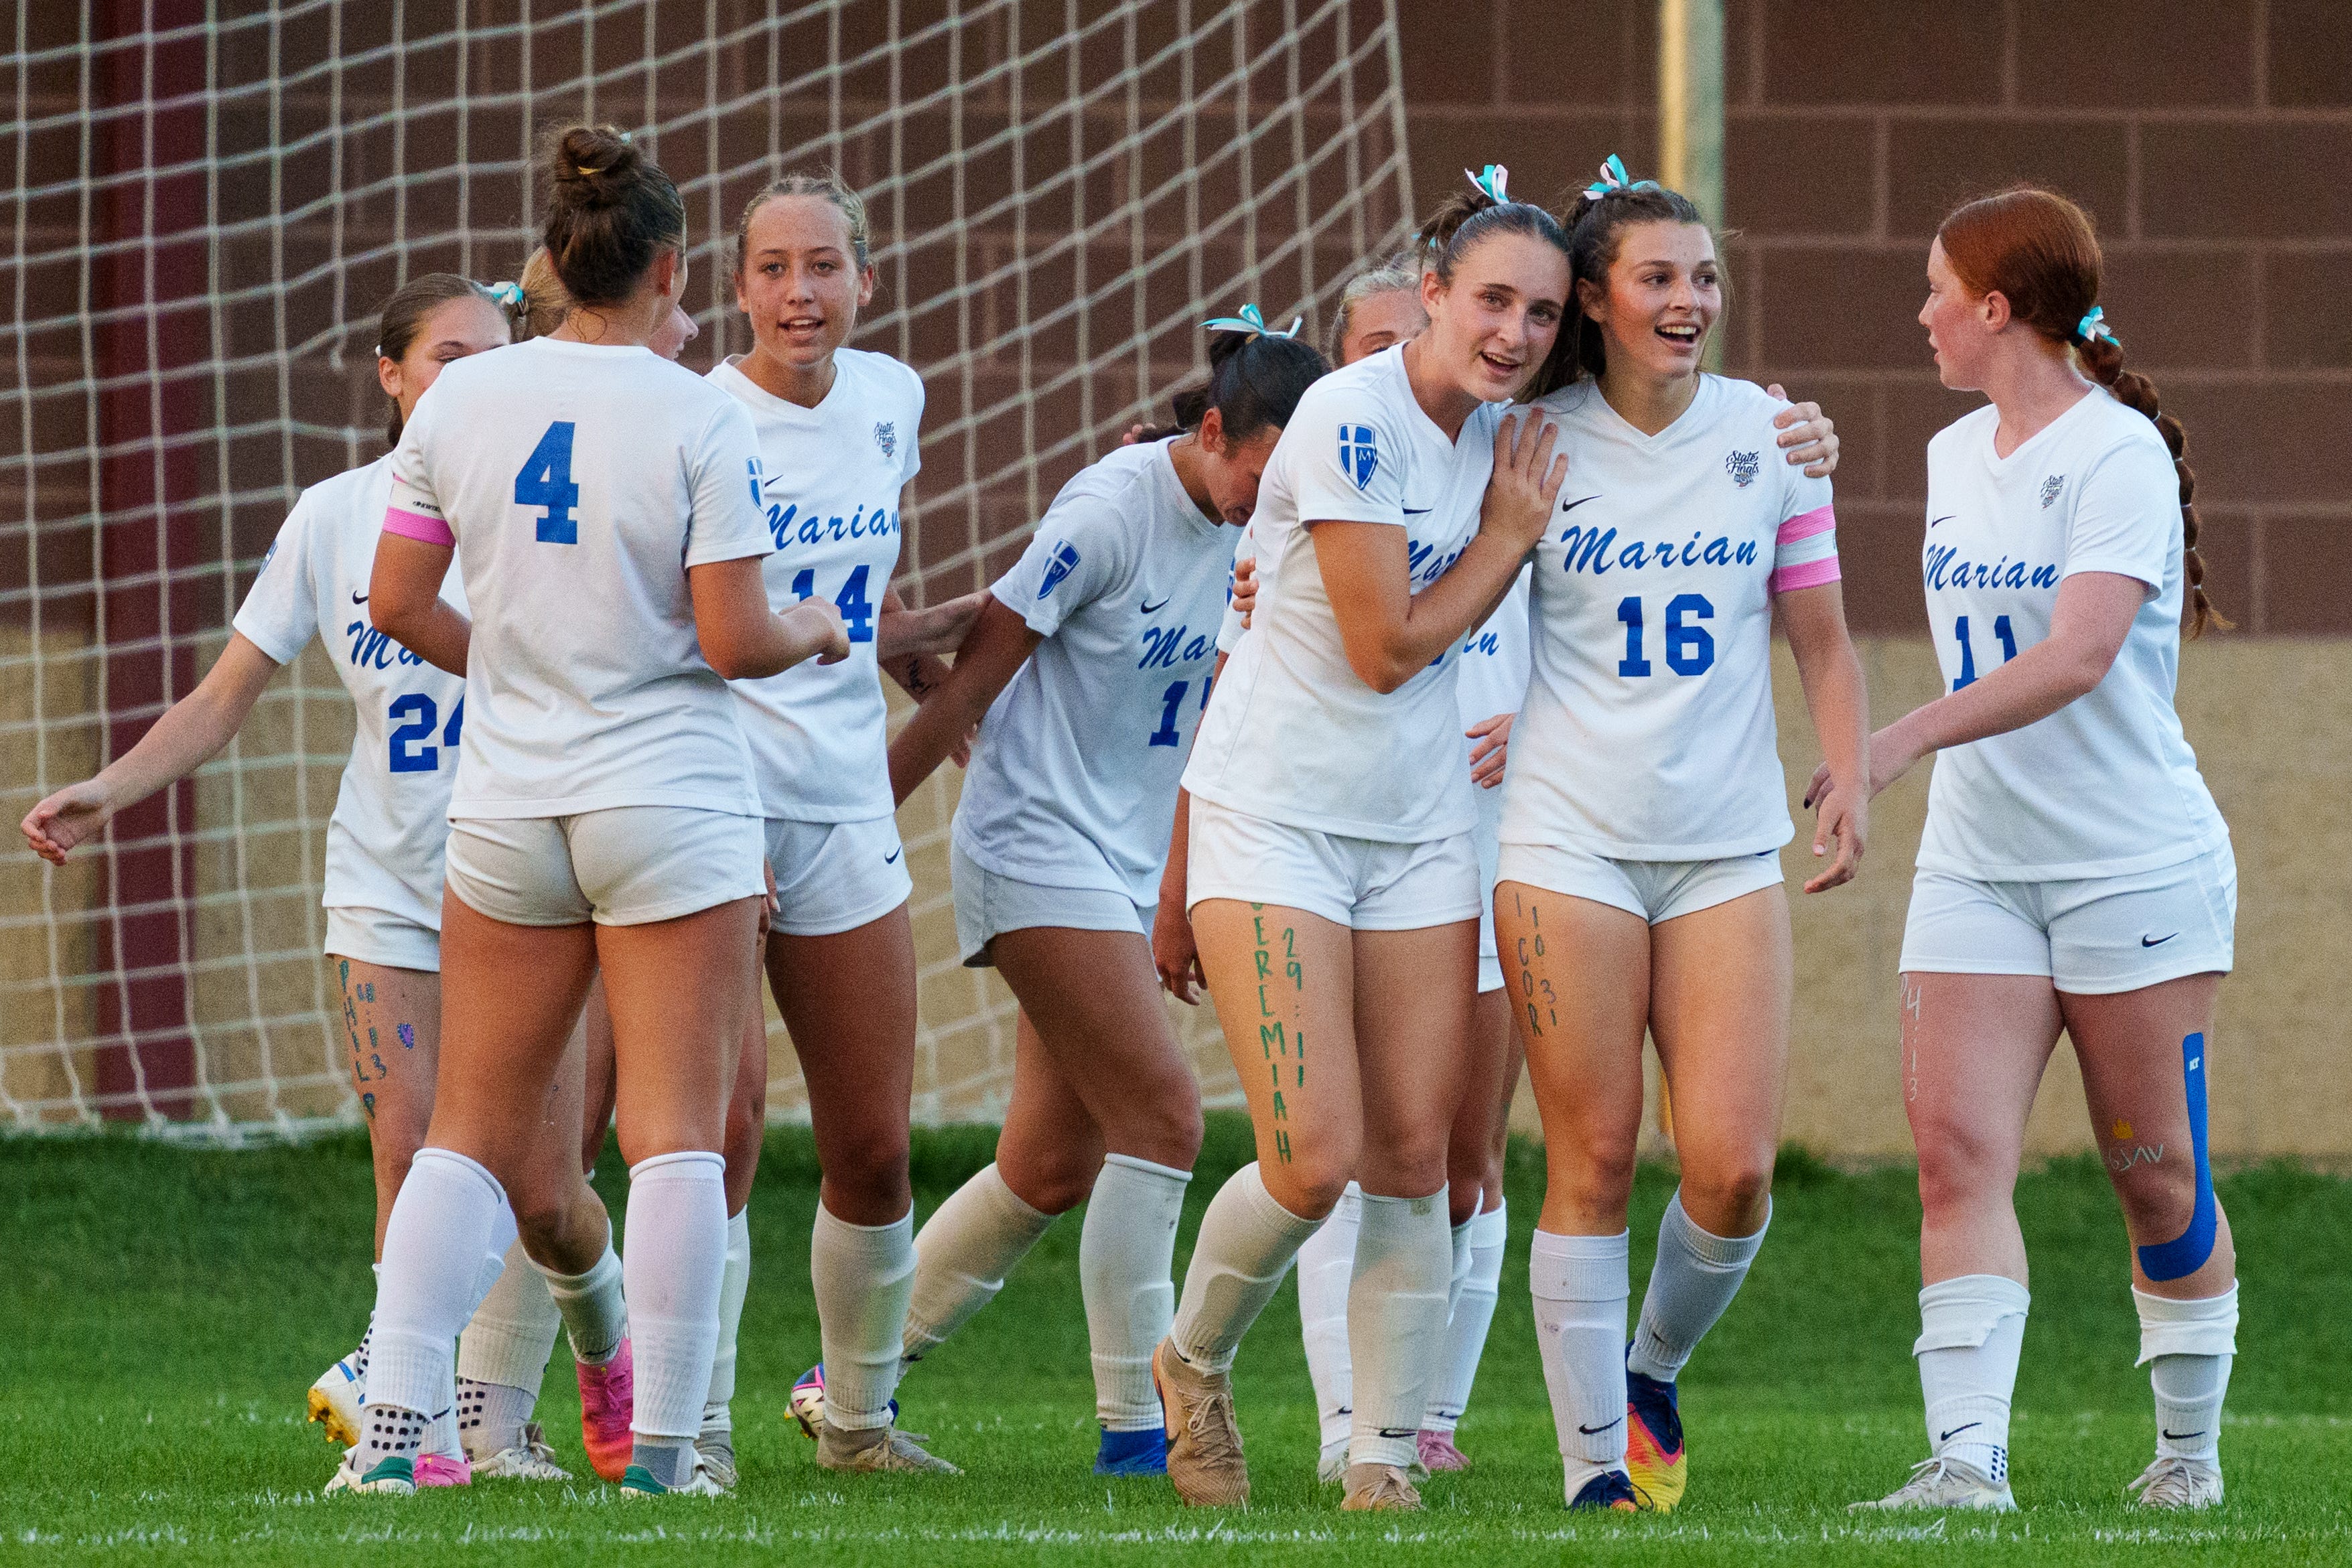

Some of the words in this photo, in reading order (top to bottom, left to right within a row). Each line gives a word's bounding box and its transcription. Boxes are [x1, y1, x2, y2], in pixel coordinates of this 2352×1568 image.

[515, 421, 579, 545] 4
[1359, 449, 1371, 461] M
[1726, 450, 1759, 463] State
[1726, 461, 1759, 474] Finals
[766, 503, 900, 551] Marian
[1560, 525, 1758, 575] Marian
[1925, 543, 2059, 591] Marian
[1617, 593, 1715, 677] 16
[1952, 615, 2018, 694] 11
[1148, 676, 1214, 747] 1
[1282, 927, 1304, 1088] 29:11
[1906, 985, 1923, 1102] 4:13
